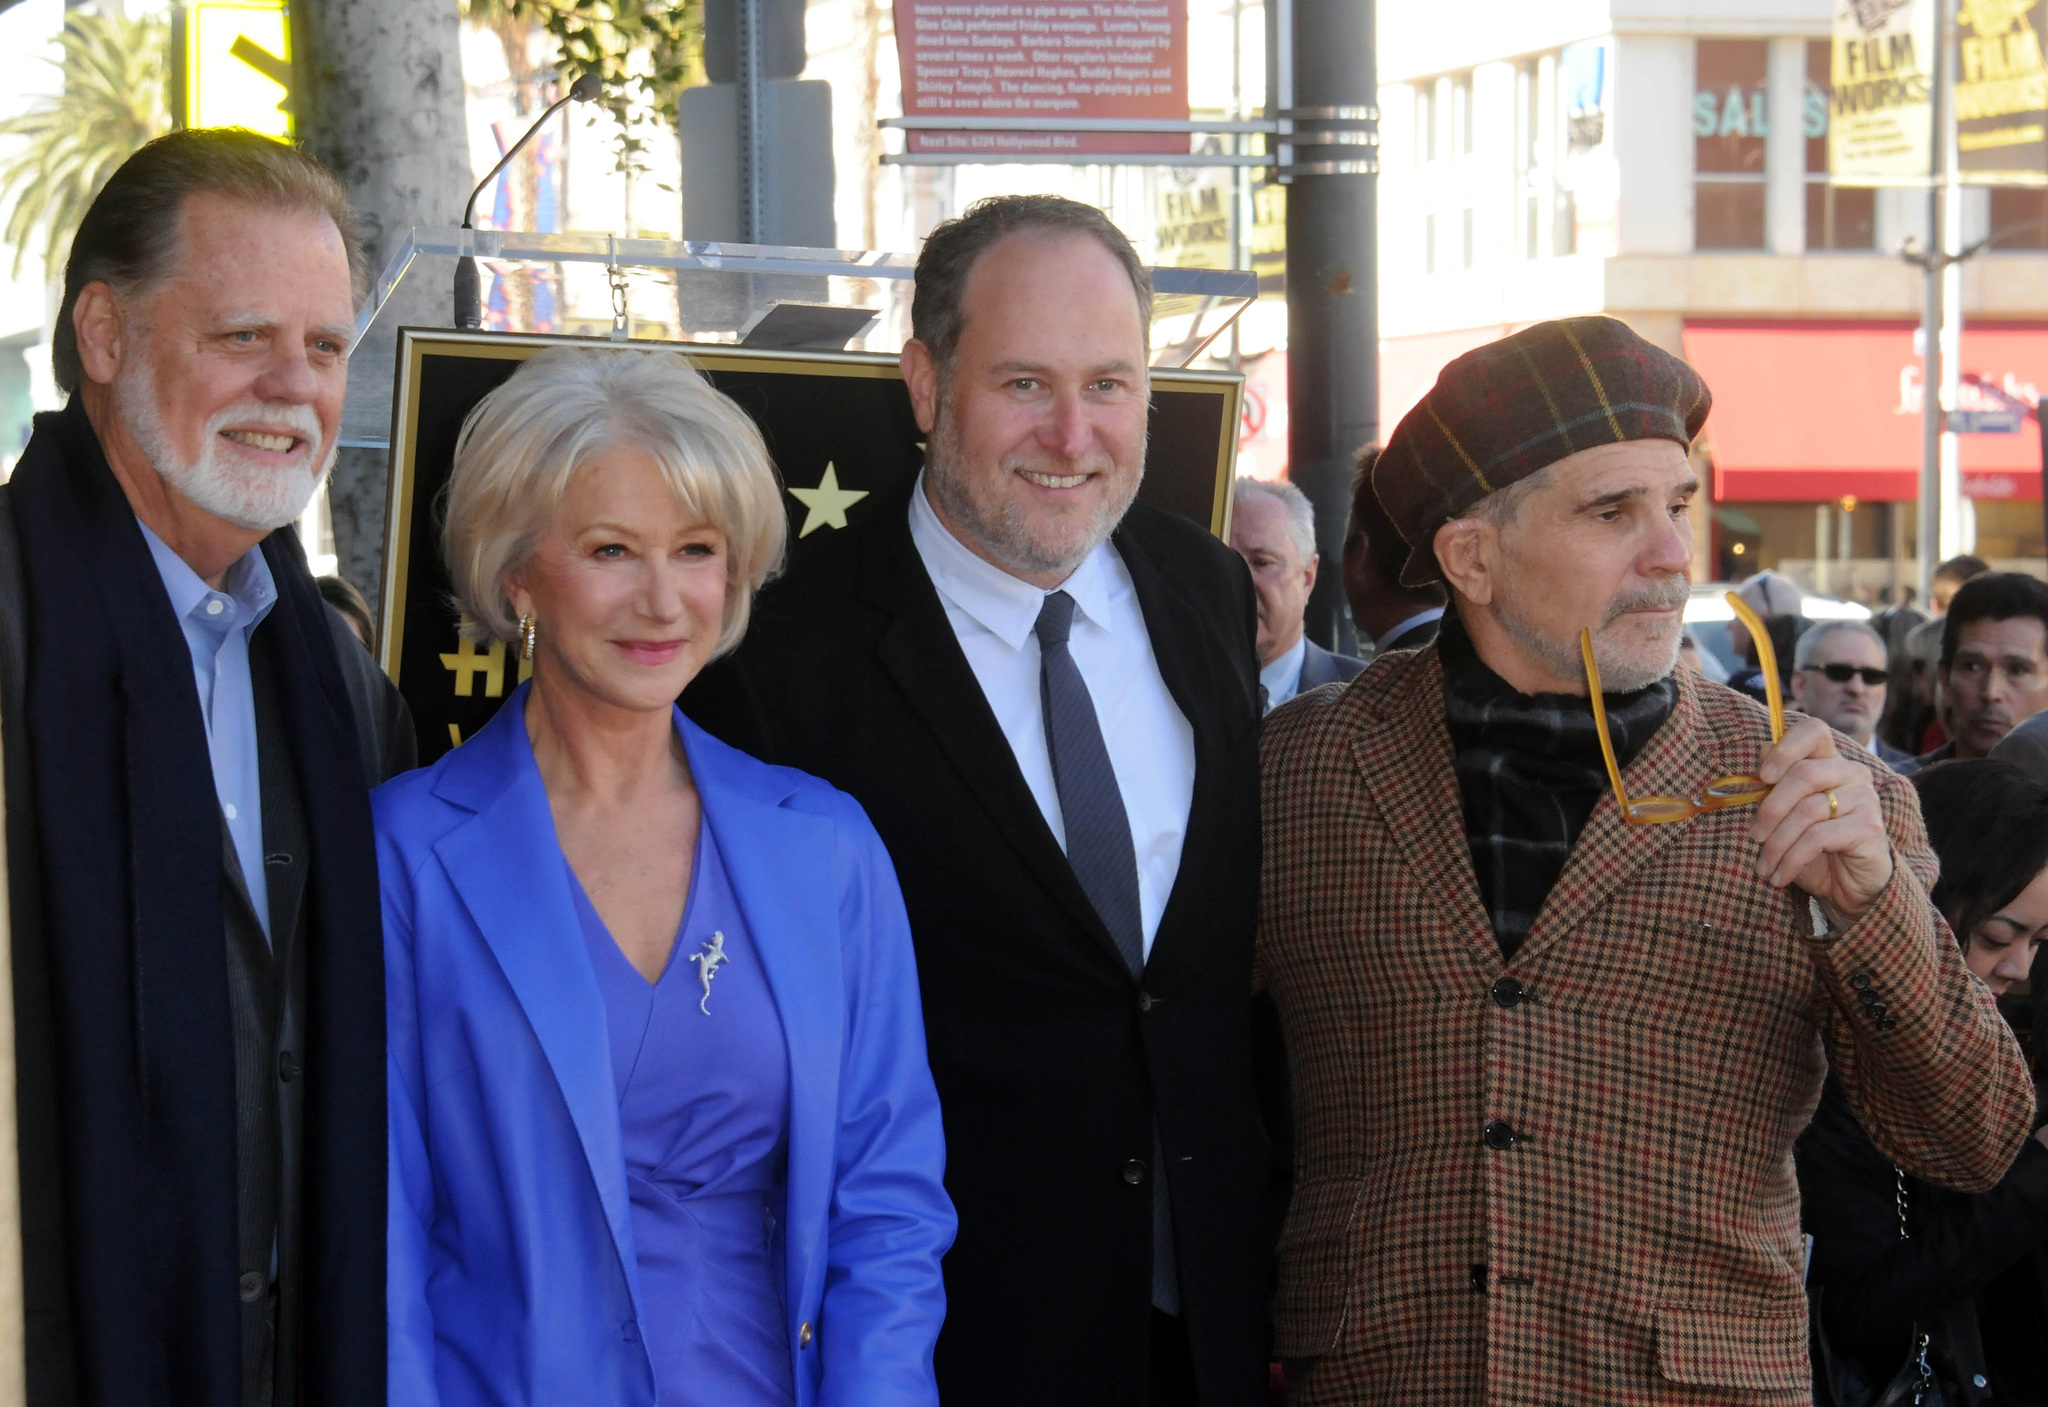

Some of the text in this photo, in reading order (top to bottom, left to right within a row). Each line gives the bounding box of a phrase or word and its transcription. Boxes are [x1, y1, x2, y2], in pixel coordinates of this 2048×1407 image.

[1846, 34, 1916, 76] FILM
[1832, 73, 1932, 116] WORKS
[920, 135, 944, 147] Next
[996, 136, 1051, 149] Hollywood
[1167, 187, 1220, 219] FILM
